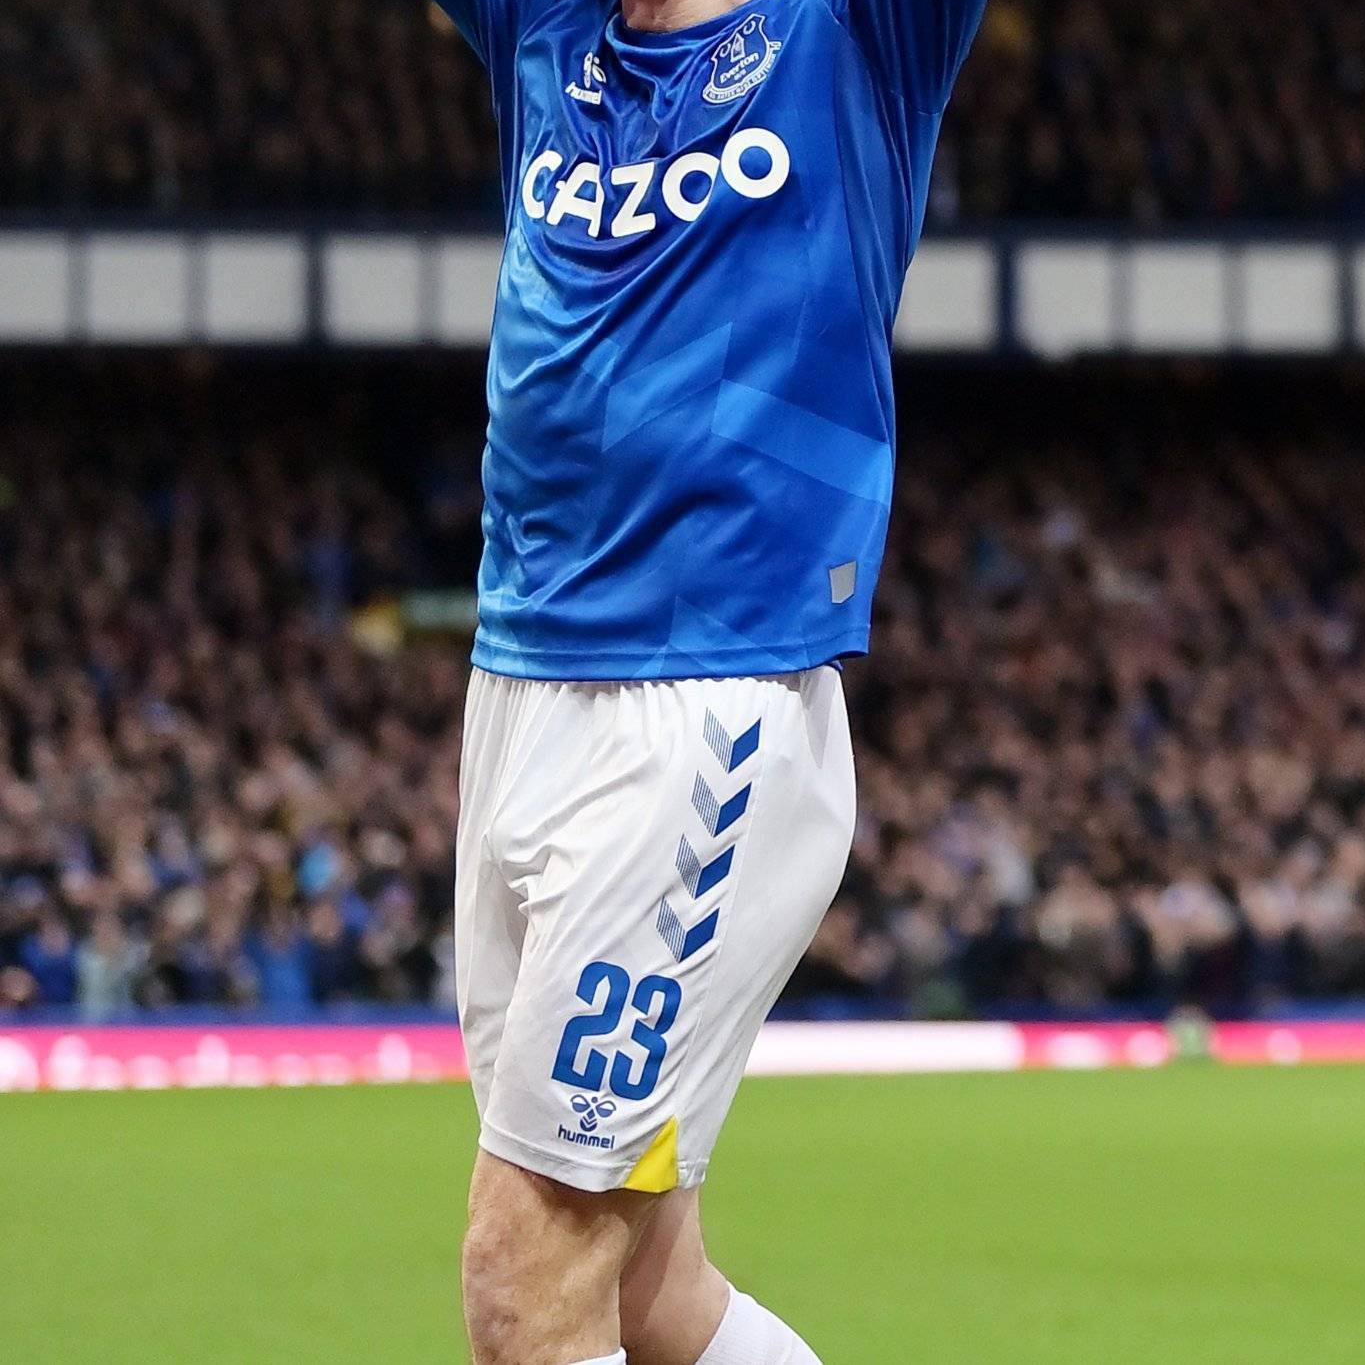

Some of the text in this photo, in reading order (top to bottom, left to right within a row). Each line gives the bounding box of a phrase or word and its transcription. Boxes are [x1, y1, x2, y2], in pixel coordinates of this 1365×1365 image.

[522, 127, 790, 238] CAZOO
[551, 961, 682, 1101] 23
[558, 1124, 615, 1150] hummel
